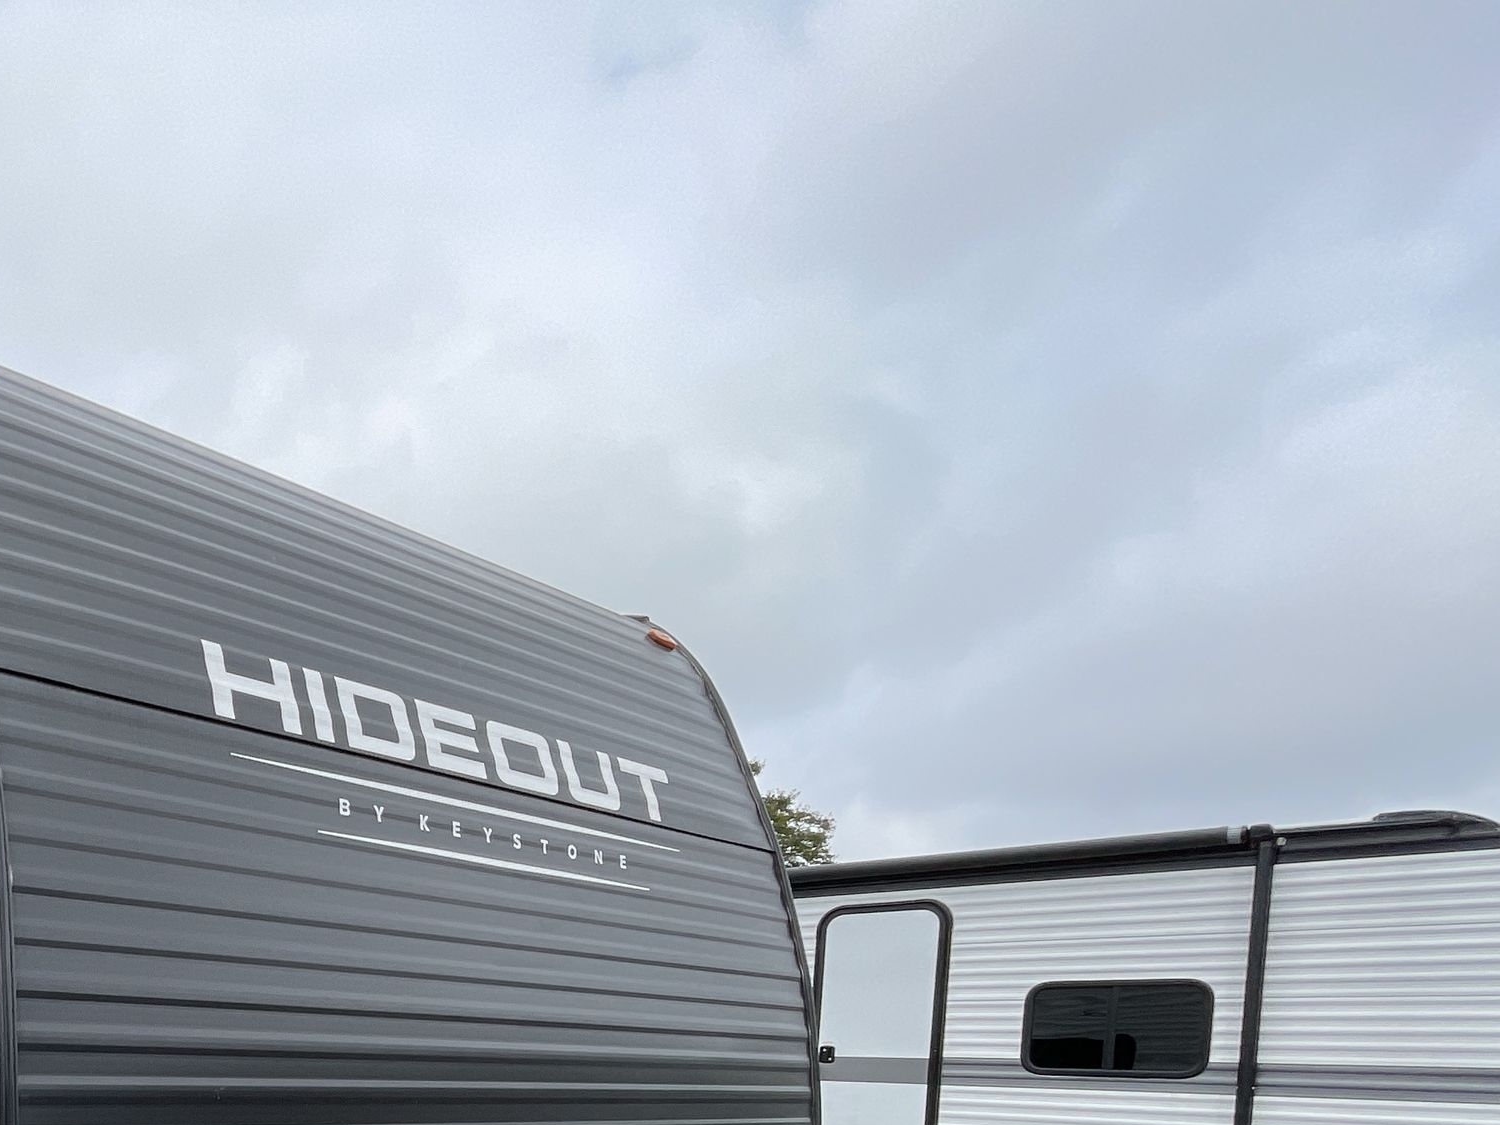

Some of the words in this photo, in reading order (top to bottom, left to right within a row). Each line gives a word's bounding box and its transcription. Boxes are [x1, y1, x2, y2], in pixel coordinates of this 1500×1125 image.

[199, 639, 670, 822] HIDEOUT
[338, 798, 384, 823] BY
[419, 814, 629, 870] KEYSTONE
